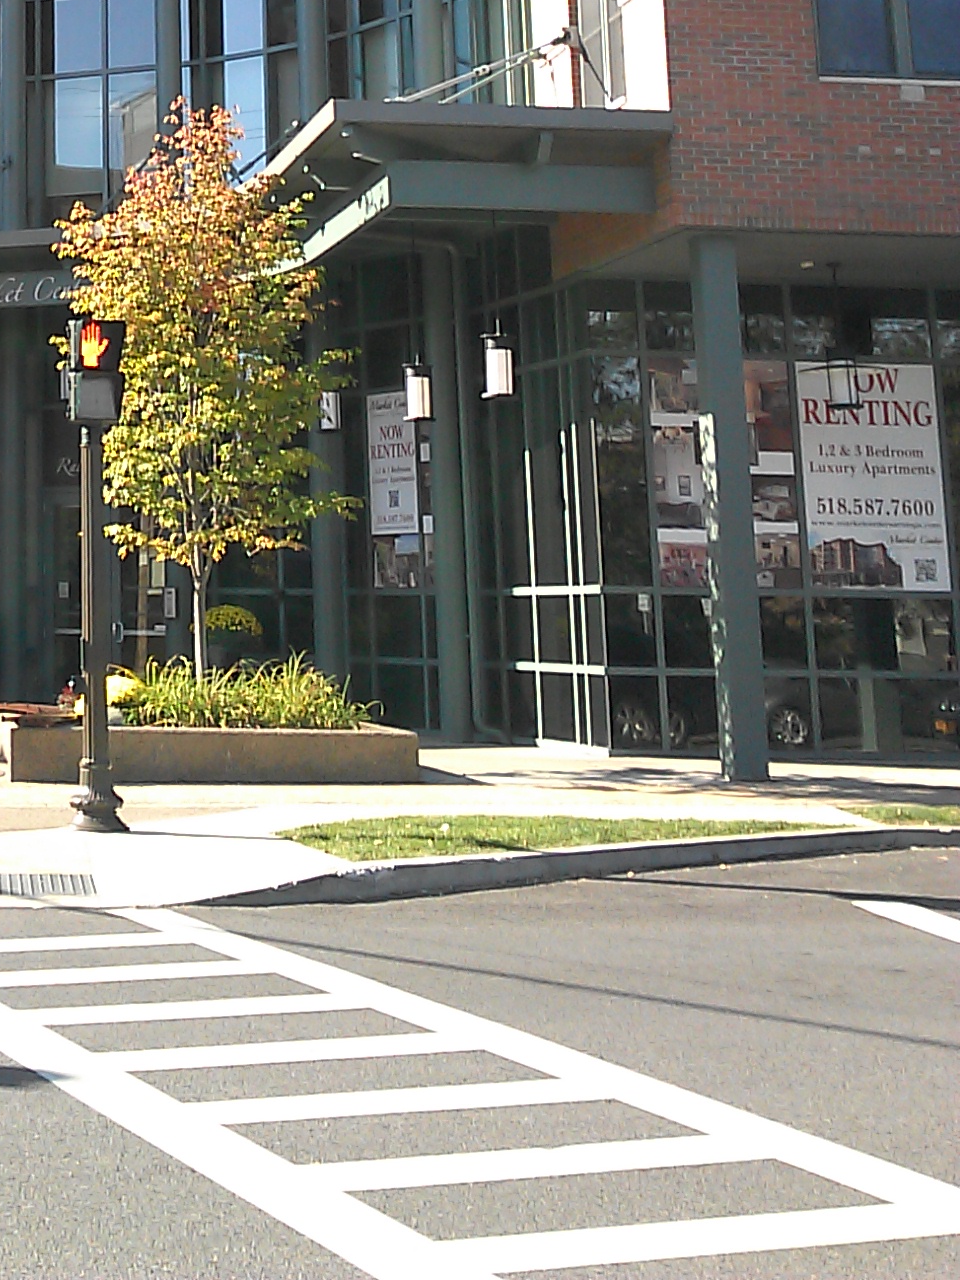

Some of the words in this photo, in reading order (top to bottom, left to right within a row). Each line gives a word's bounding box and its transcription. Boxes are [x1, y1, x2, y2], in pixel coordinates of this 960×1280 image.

[801, 398, 933, 427] RENTING
[380, 425, 404, 440] NOW
[370, 441, 415, 459] RENTING
[839, 446, 851, 457] &
[854, 444, 862, 457] 3
[866, 444, 924, 459] Bedroom
[809, 461, 857, 478] Luxury
[862, 461, 937, 479] Apartments
[817, 497, 936, 517] 518.587.7600
